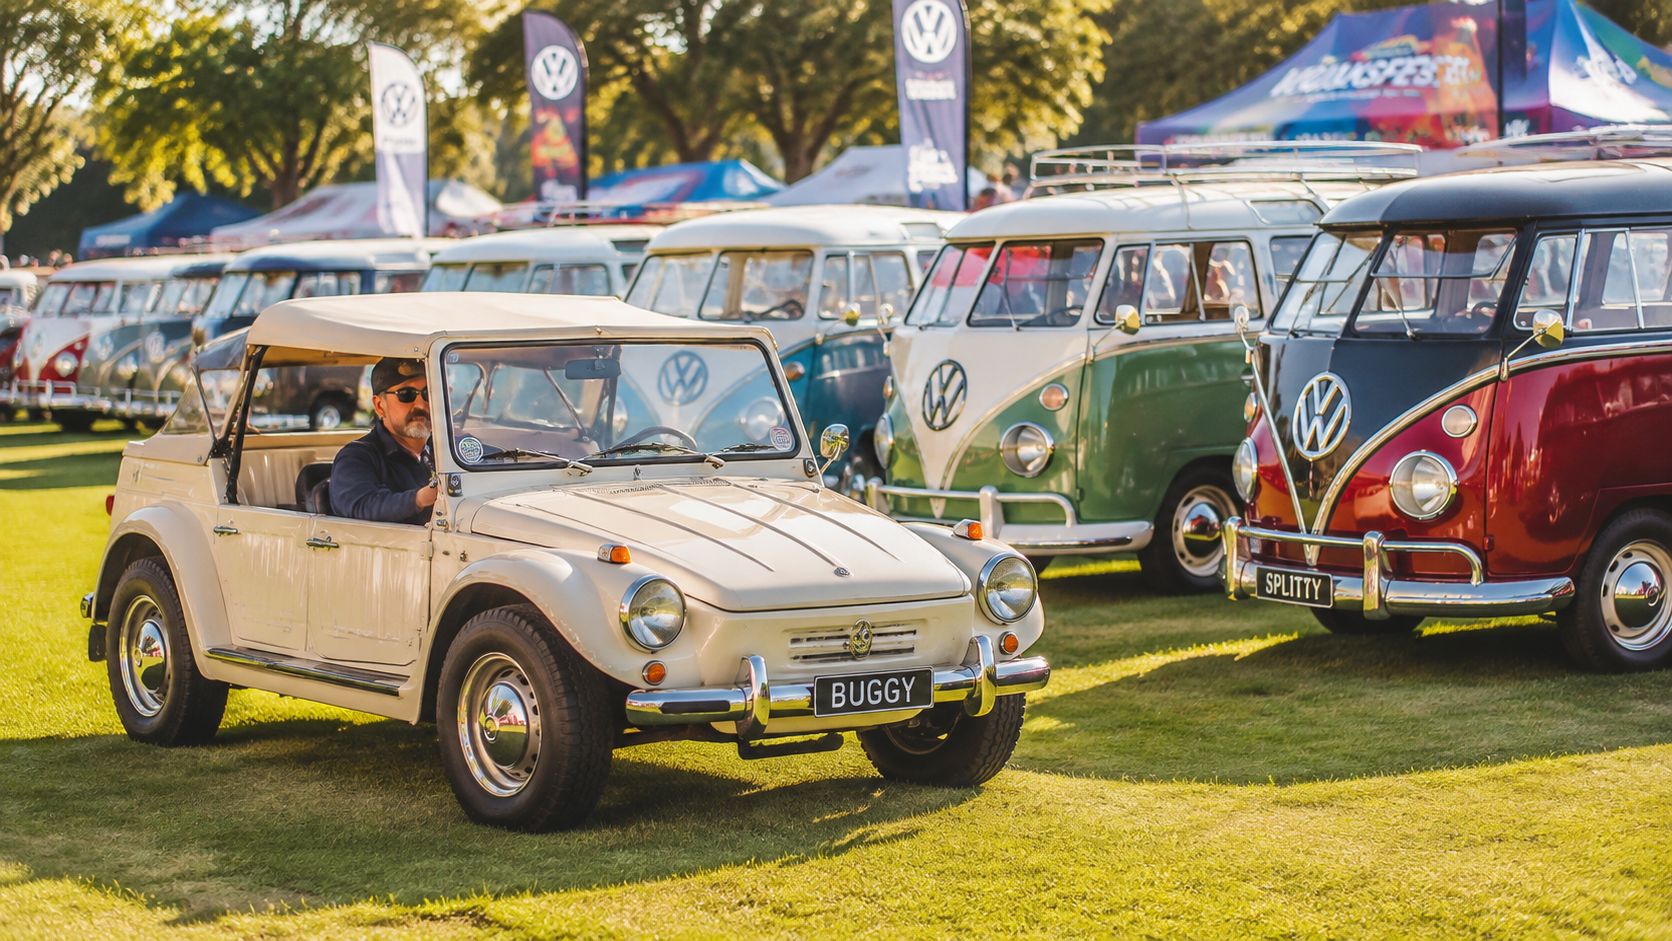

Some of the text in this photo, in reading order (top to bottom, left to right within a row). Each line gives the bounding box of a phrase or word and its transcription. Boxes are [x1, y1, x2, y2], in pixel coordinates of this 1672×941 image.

[903, 2, 956, 62] VW
[660, 352, 707, 404] VW
[923, 361, 966, 429] VW
[1294, 372, 1350, 458] VW
[1265, 572, 1322, 600] SPLITTY
[831, 676, 916, 709] BUGGY
